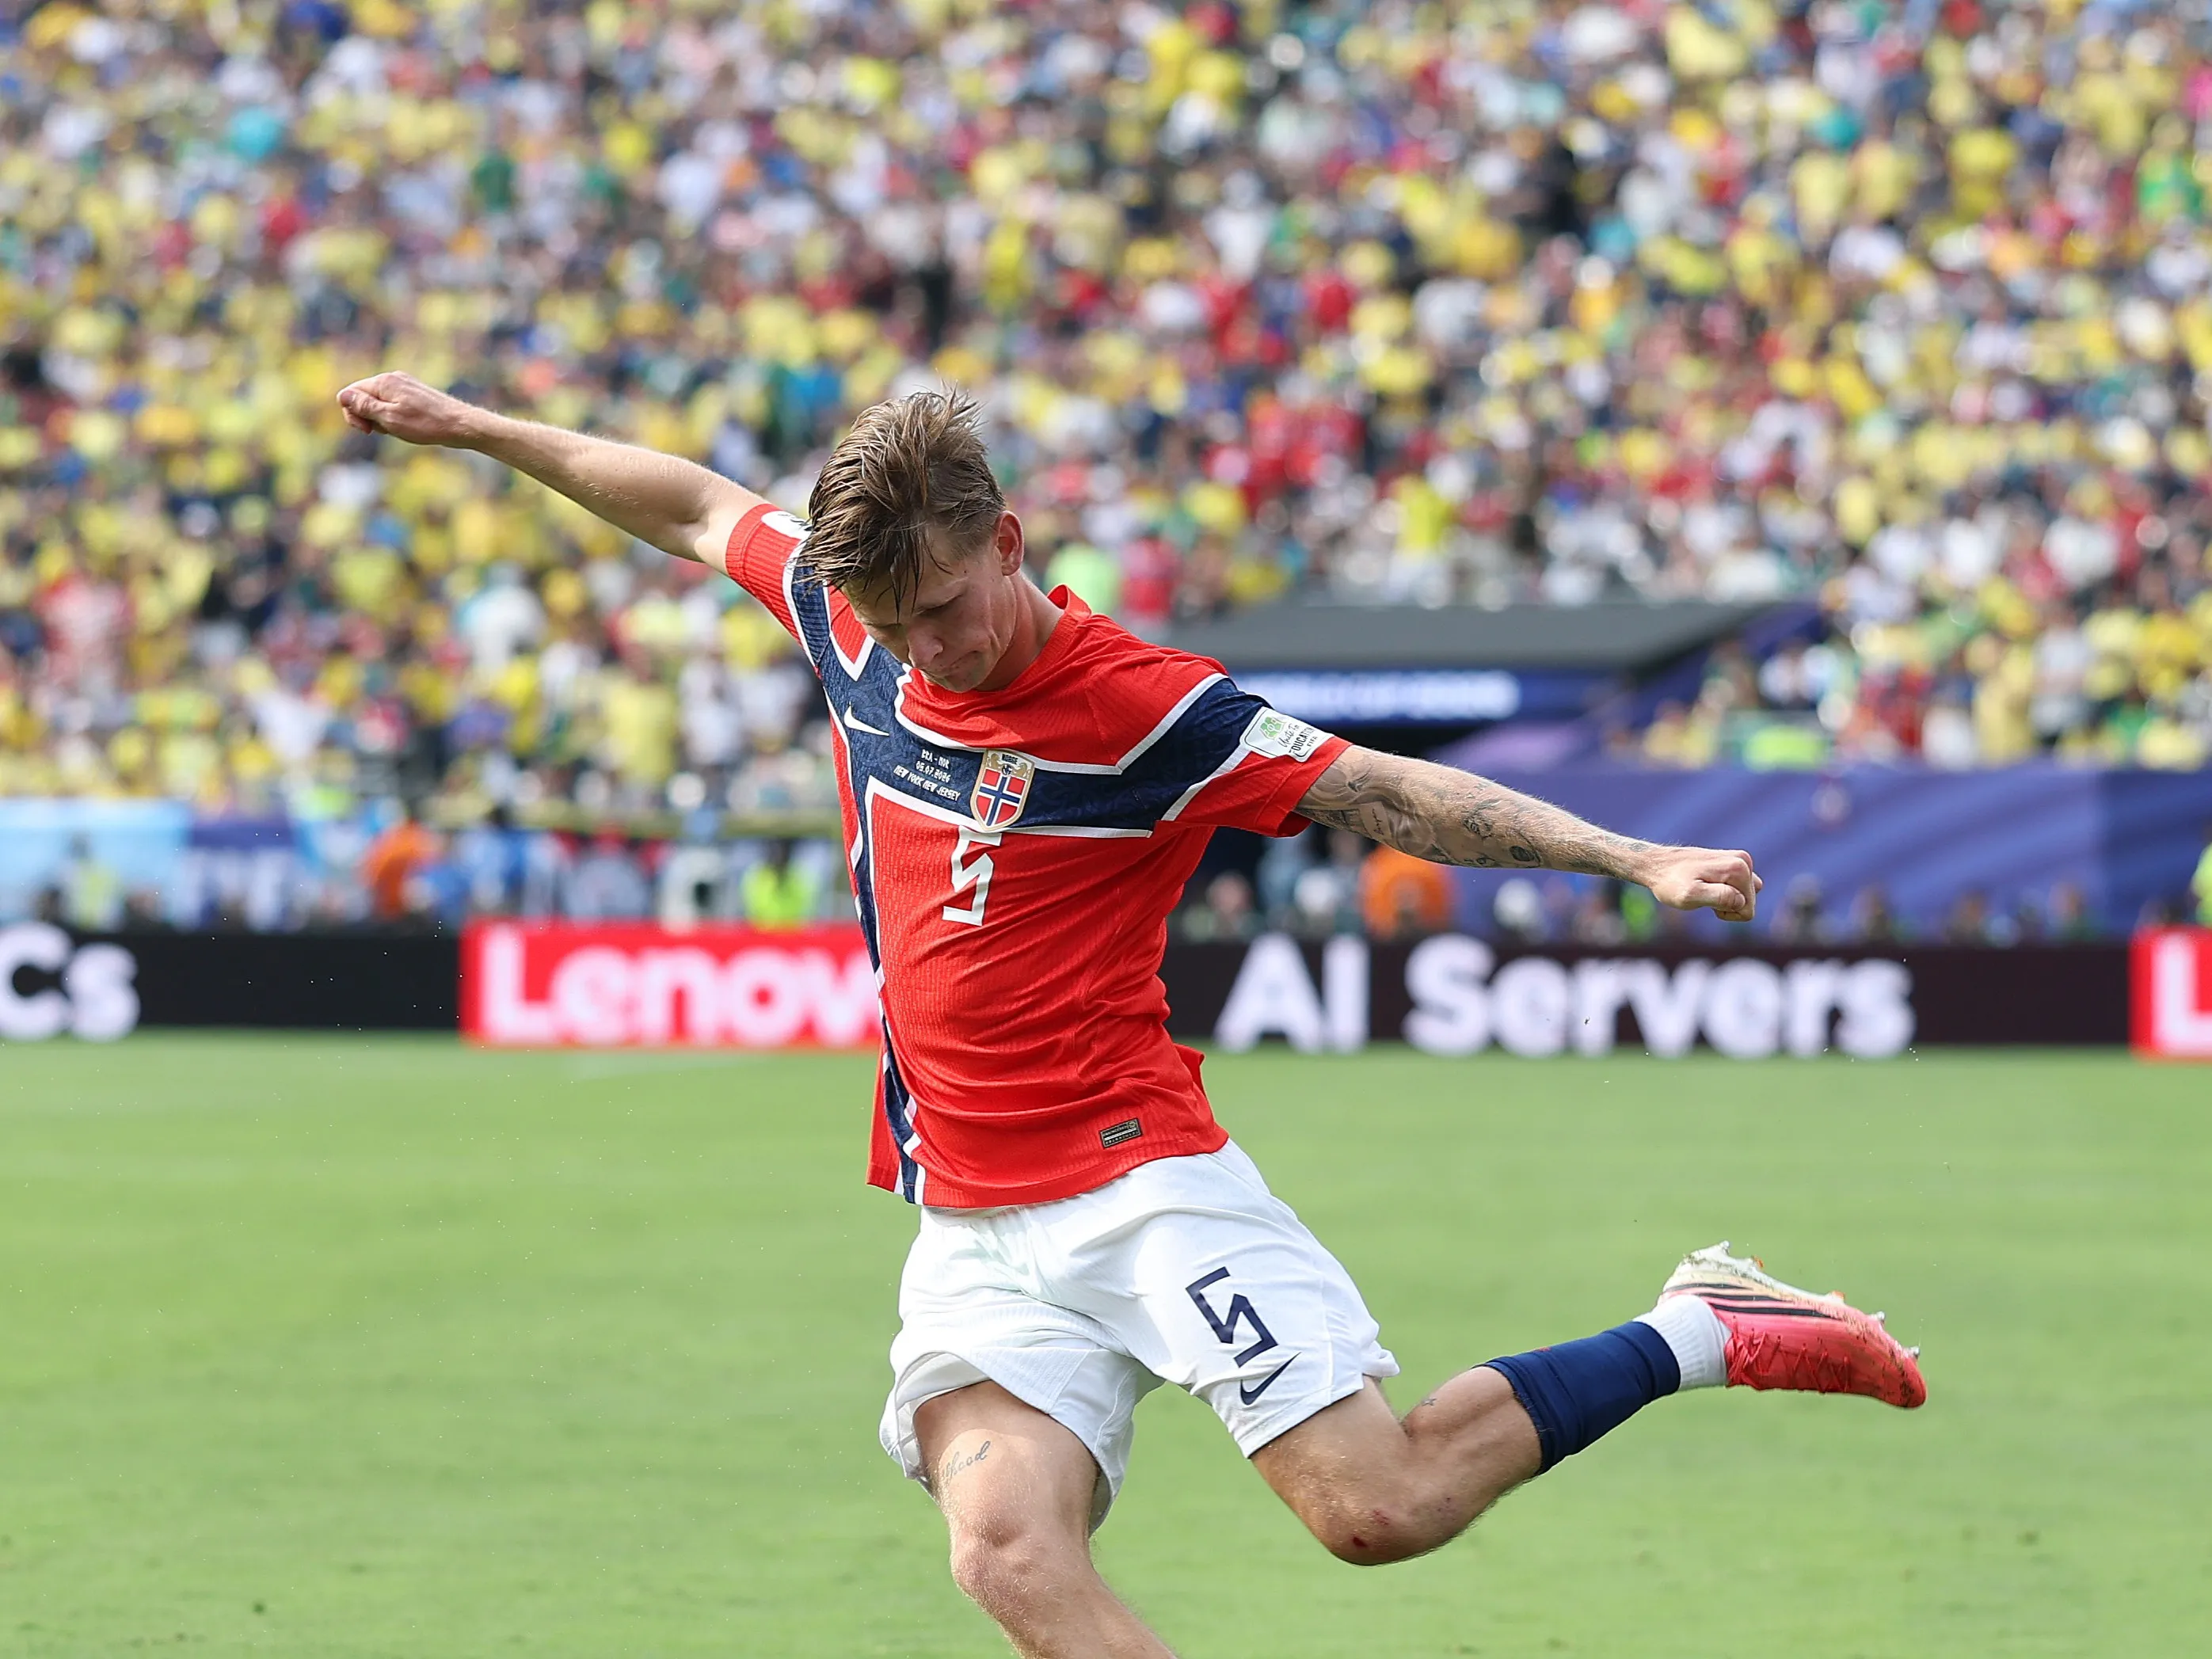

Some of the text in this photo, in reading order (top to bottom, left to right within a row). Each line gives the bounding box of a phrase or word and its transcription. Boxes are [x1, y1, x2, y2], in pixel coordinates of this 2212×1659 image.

[893, 764, 961, 801] NEW YORK NEW JERSEY
[916, 760, 951, 783] 05.07.2026
[921, 748, 933, 763] BRA
[938, 756, 950, 770] NOR
[942, 824, 1003, 927] 5
[1214, 933, 1915, 1059] AI Servers
[1186, 1266, 1279, 1368] 5
